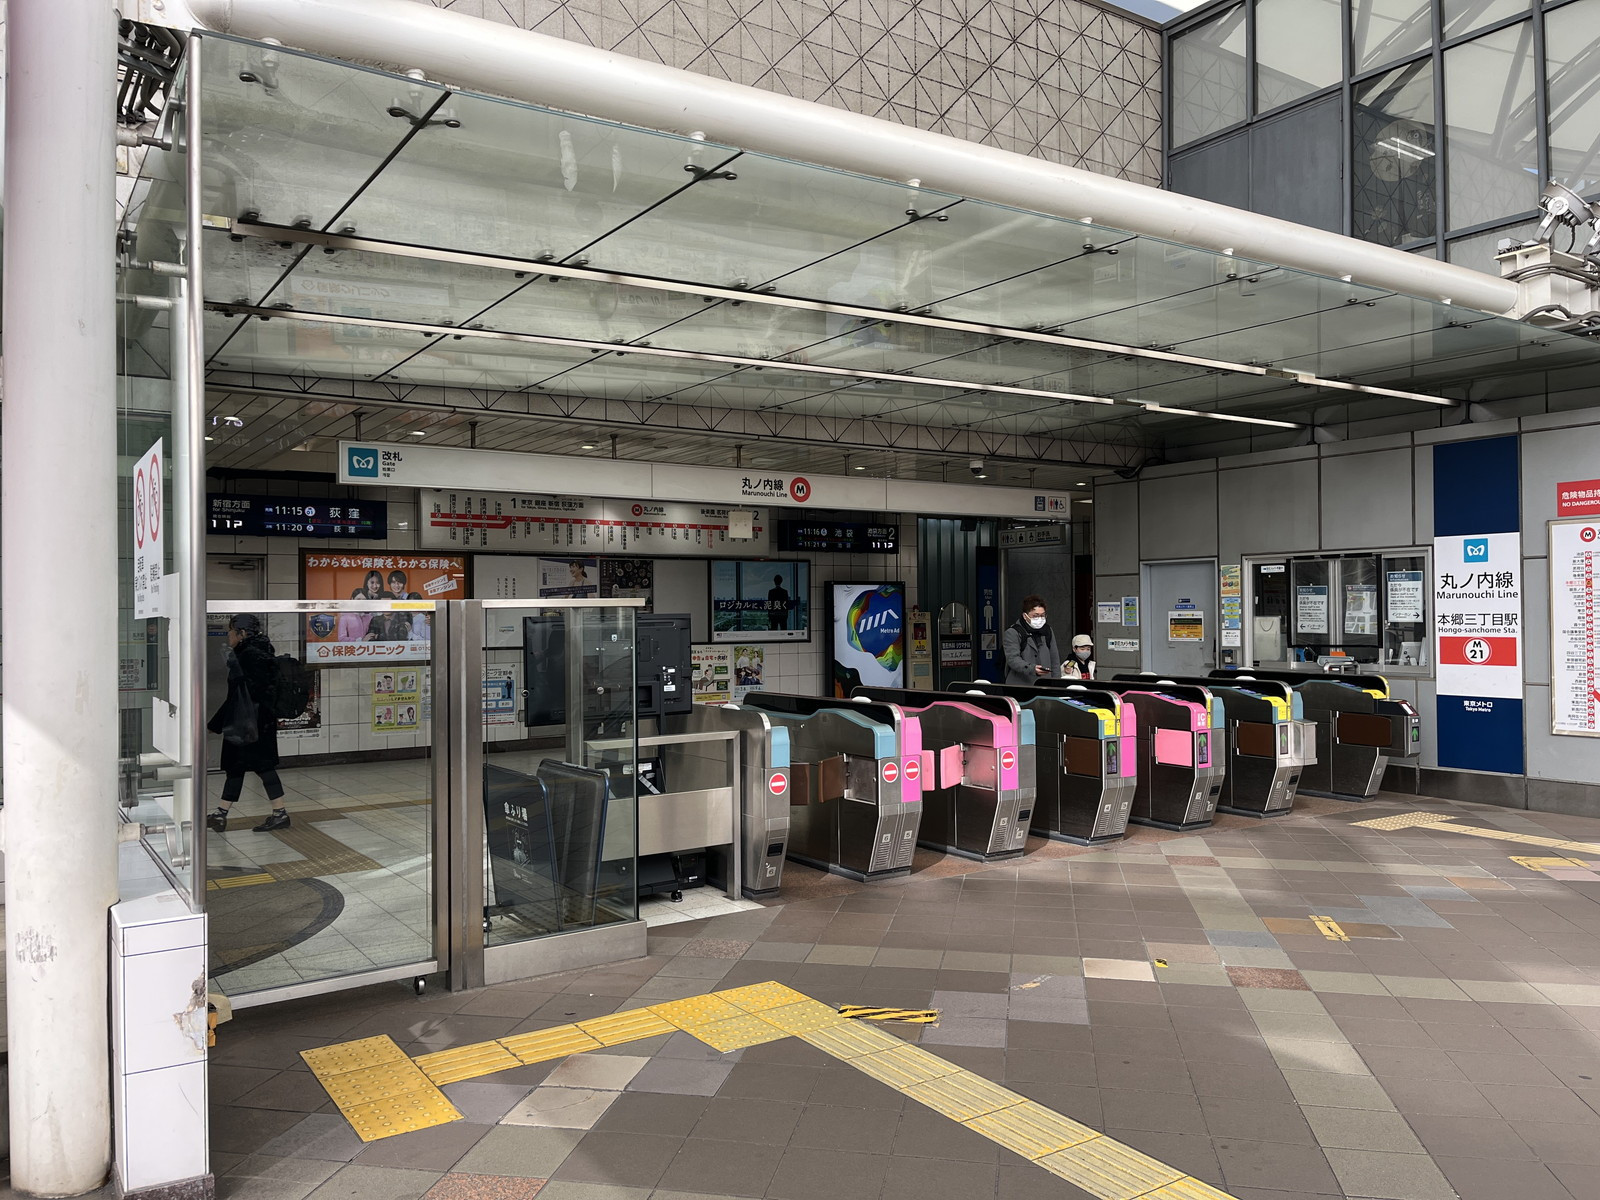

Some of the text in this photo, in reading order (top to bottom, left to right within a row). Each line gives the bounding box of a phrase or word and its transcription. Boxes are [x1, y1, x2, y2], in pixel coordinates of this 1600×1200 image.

[382, 451, 402, 461] 改札
[742, 477, 784, 491] 丸ノ内線
[796, 485, 805, 494] M
[212, 499, 250, 508] 新宿方面
[511, 497, 516, 508] 1
[275, 506, 303, 515] 11:15
[753, 511, 759, 520] 2
[276, 524, 303, 532] 11:20
[889, 528, 895, 539] 2
[1440, 571, 1514, 589] 丸ノ内線
[1437, 590, 1518, 599] Marunouchi Line
[1437, 613, 1518, 626] 本郷三丁目駅
[332, 645, 405, 656] 保険クリニック
[1470, 650, 1483, 658] 21
[1198, 713, 1206, 722] IC
